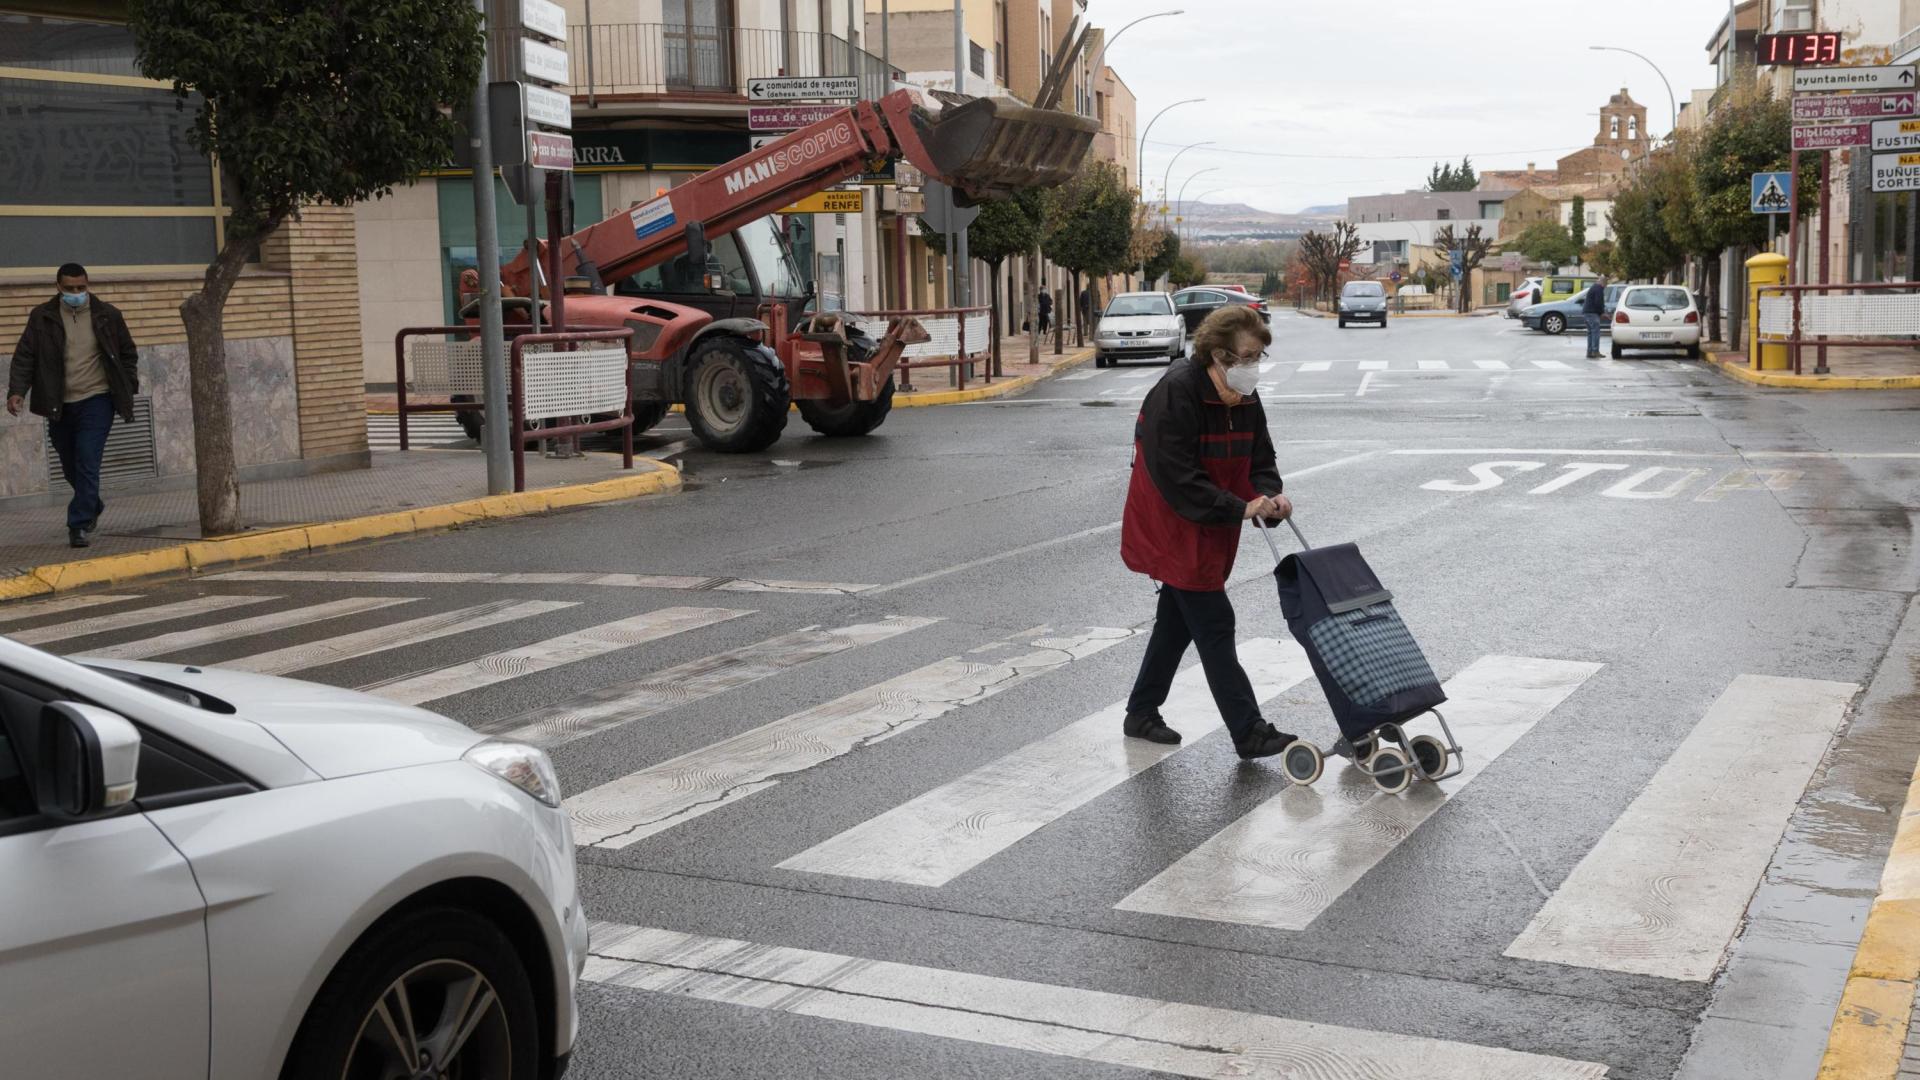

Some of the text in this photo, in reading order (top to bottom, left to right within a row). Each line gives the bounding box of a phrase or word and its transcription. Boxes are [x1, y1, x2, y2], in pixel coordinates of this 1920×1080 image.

[766, 78, 857, 90] comunidad de regantes
[1796, 73, 1878, 86] ayuntamiento
[828, 89, 857, 97] huerta)
[751, 111, 835, 122] casa de cultur
[1795, 107, 1818, 117] San
[1795, 127, 1857, 138] biblioteca
[724, 122, 852, 195] MANISCOPIC
[823, 200, 860, 210] RENFE
[1418, 460, 1804, 502] STOP
